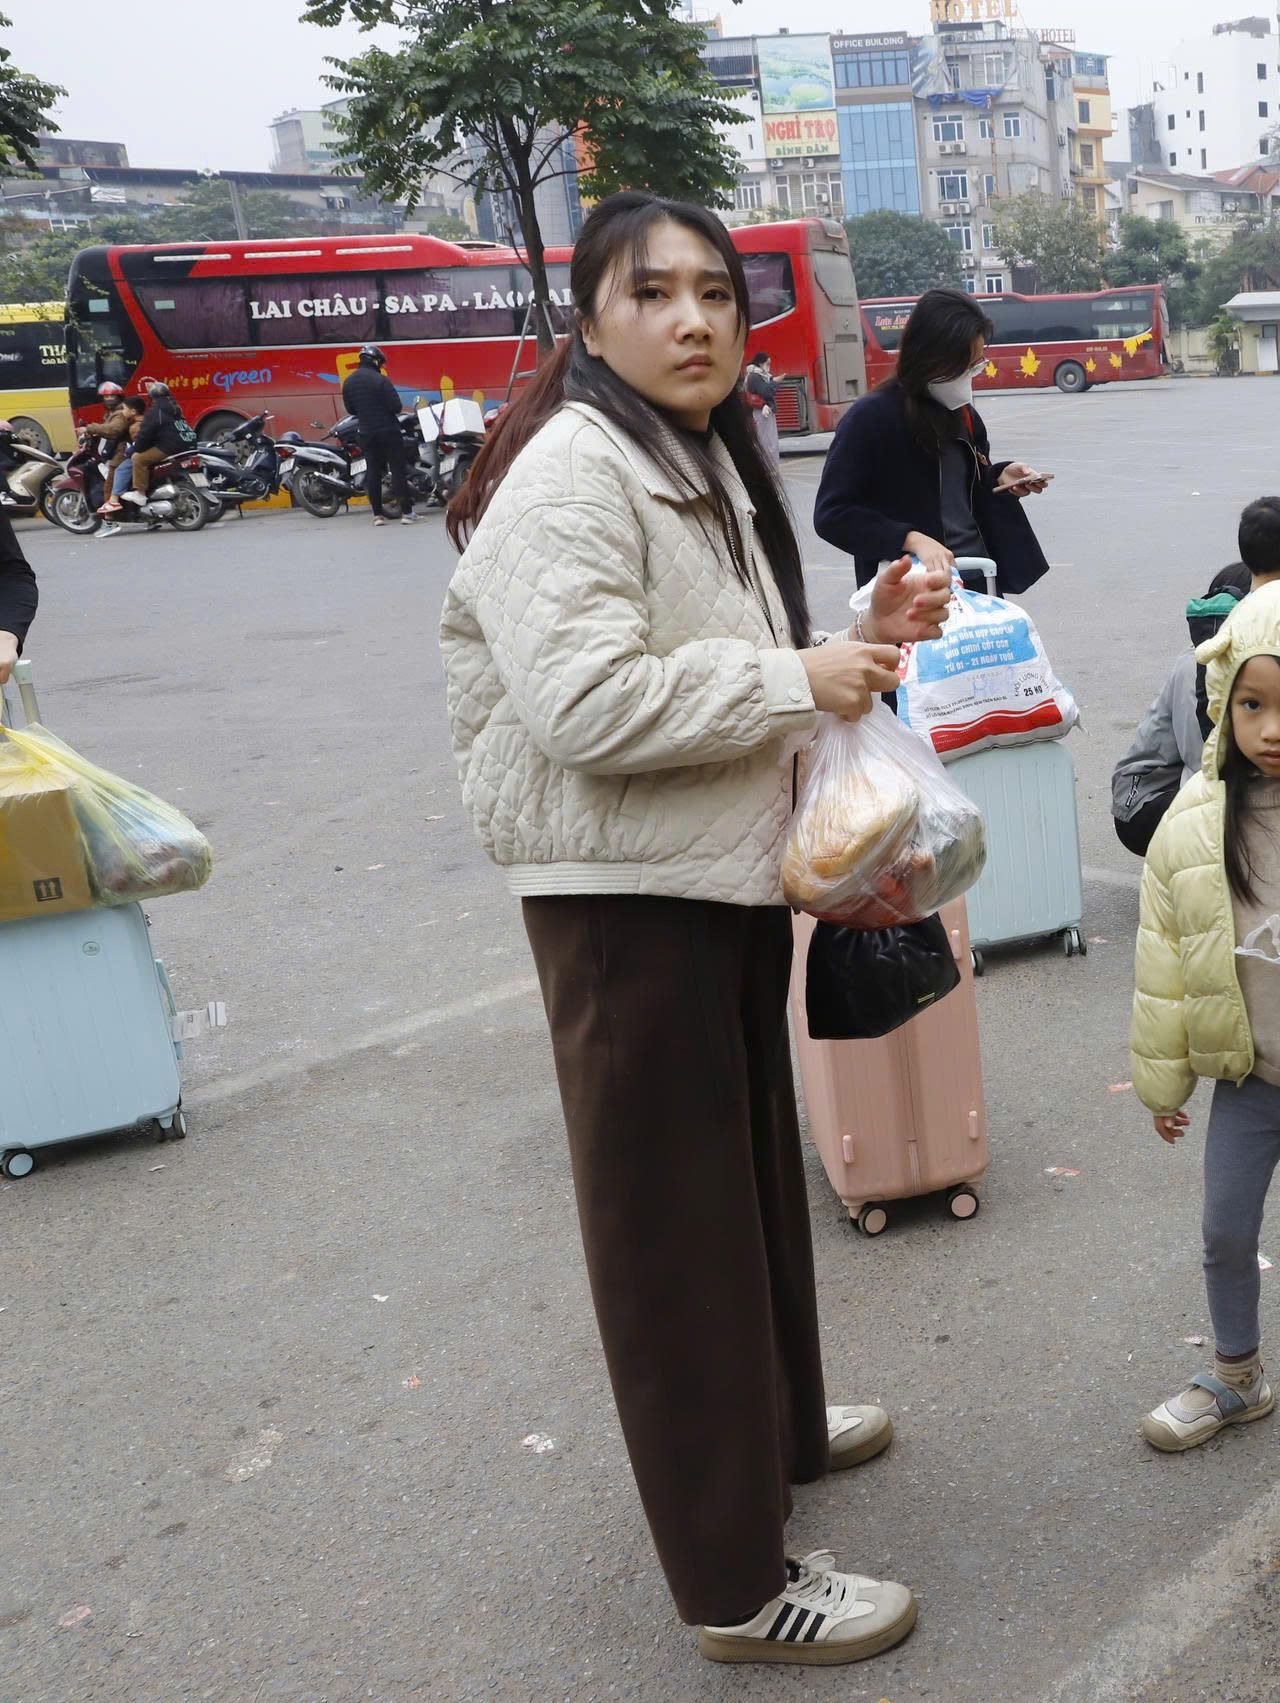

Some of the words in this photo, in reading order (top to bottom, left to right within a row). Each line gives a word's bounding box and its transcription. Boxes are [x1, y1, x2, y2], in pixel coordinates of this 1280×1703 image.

[931, 0, 1017, 23] HOTEL
[833, 39, 864, 49] OFFICE
[865, 36, 904, 47] BUILDING
[1040, 28, 1076, 42] HOTEL
[250, 301, 292, 320] LAI
[298, 292, 367, 318] CHÂU
[385, 295, 419, 314] SA
[422, 294, 457, 312] PA
[473, 285, 524, 310] LÀO
[213, 368, 272, 392] Green
[1024, 687, 1034, 697] 25
